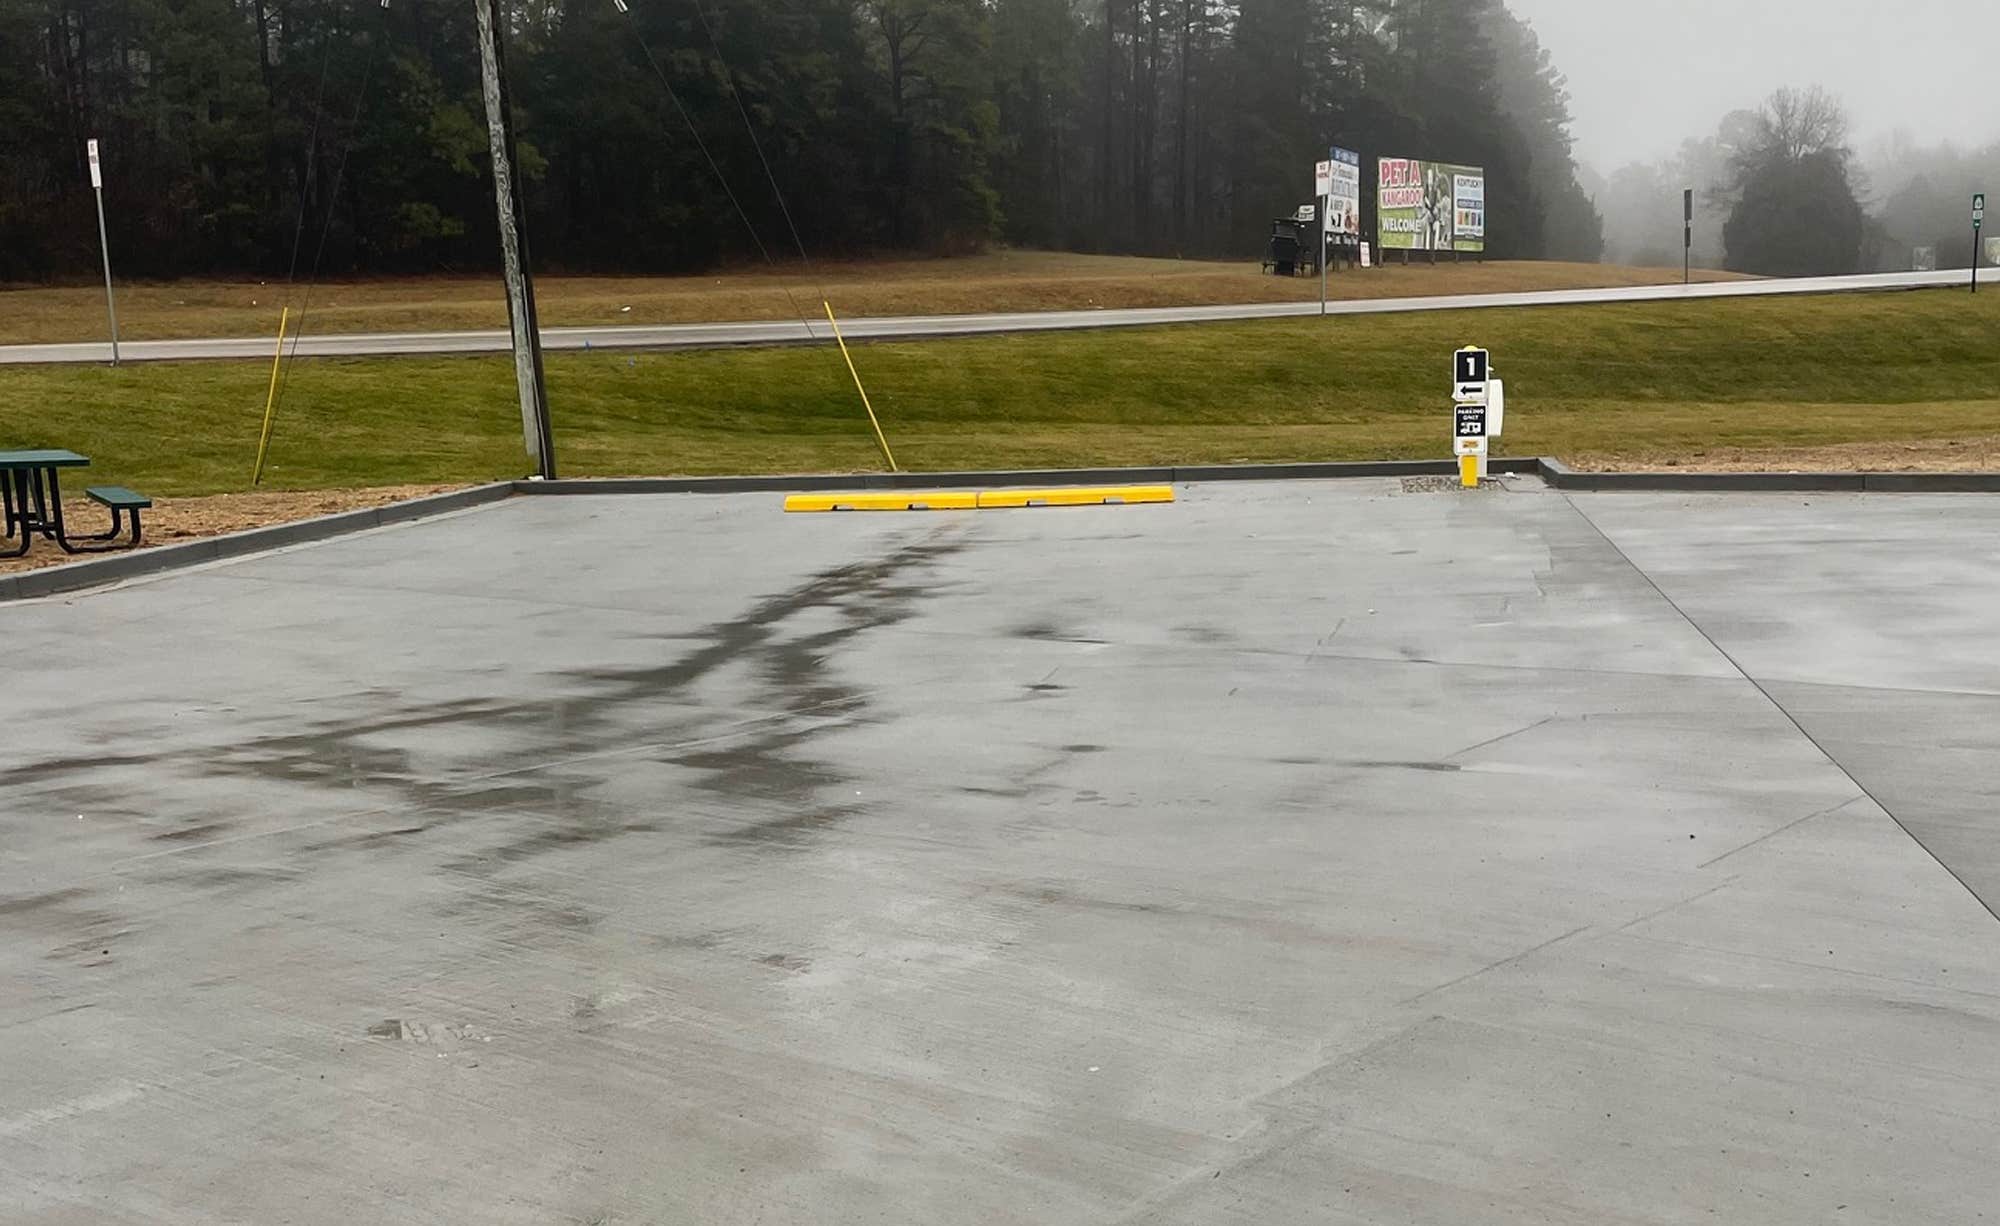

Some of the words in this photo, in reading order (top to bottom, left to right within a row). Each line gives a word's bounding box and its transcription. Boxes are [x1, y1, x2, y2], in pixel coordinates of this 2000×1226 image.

[1381, 160, 1407, 187] PET
[1410, 160, 1421, 186] A
[1382, 218, 1421, 233] WELCOME
[1466, 357, 1475, 376] 1
